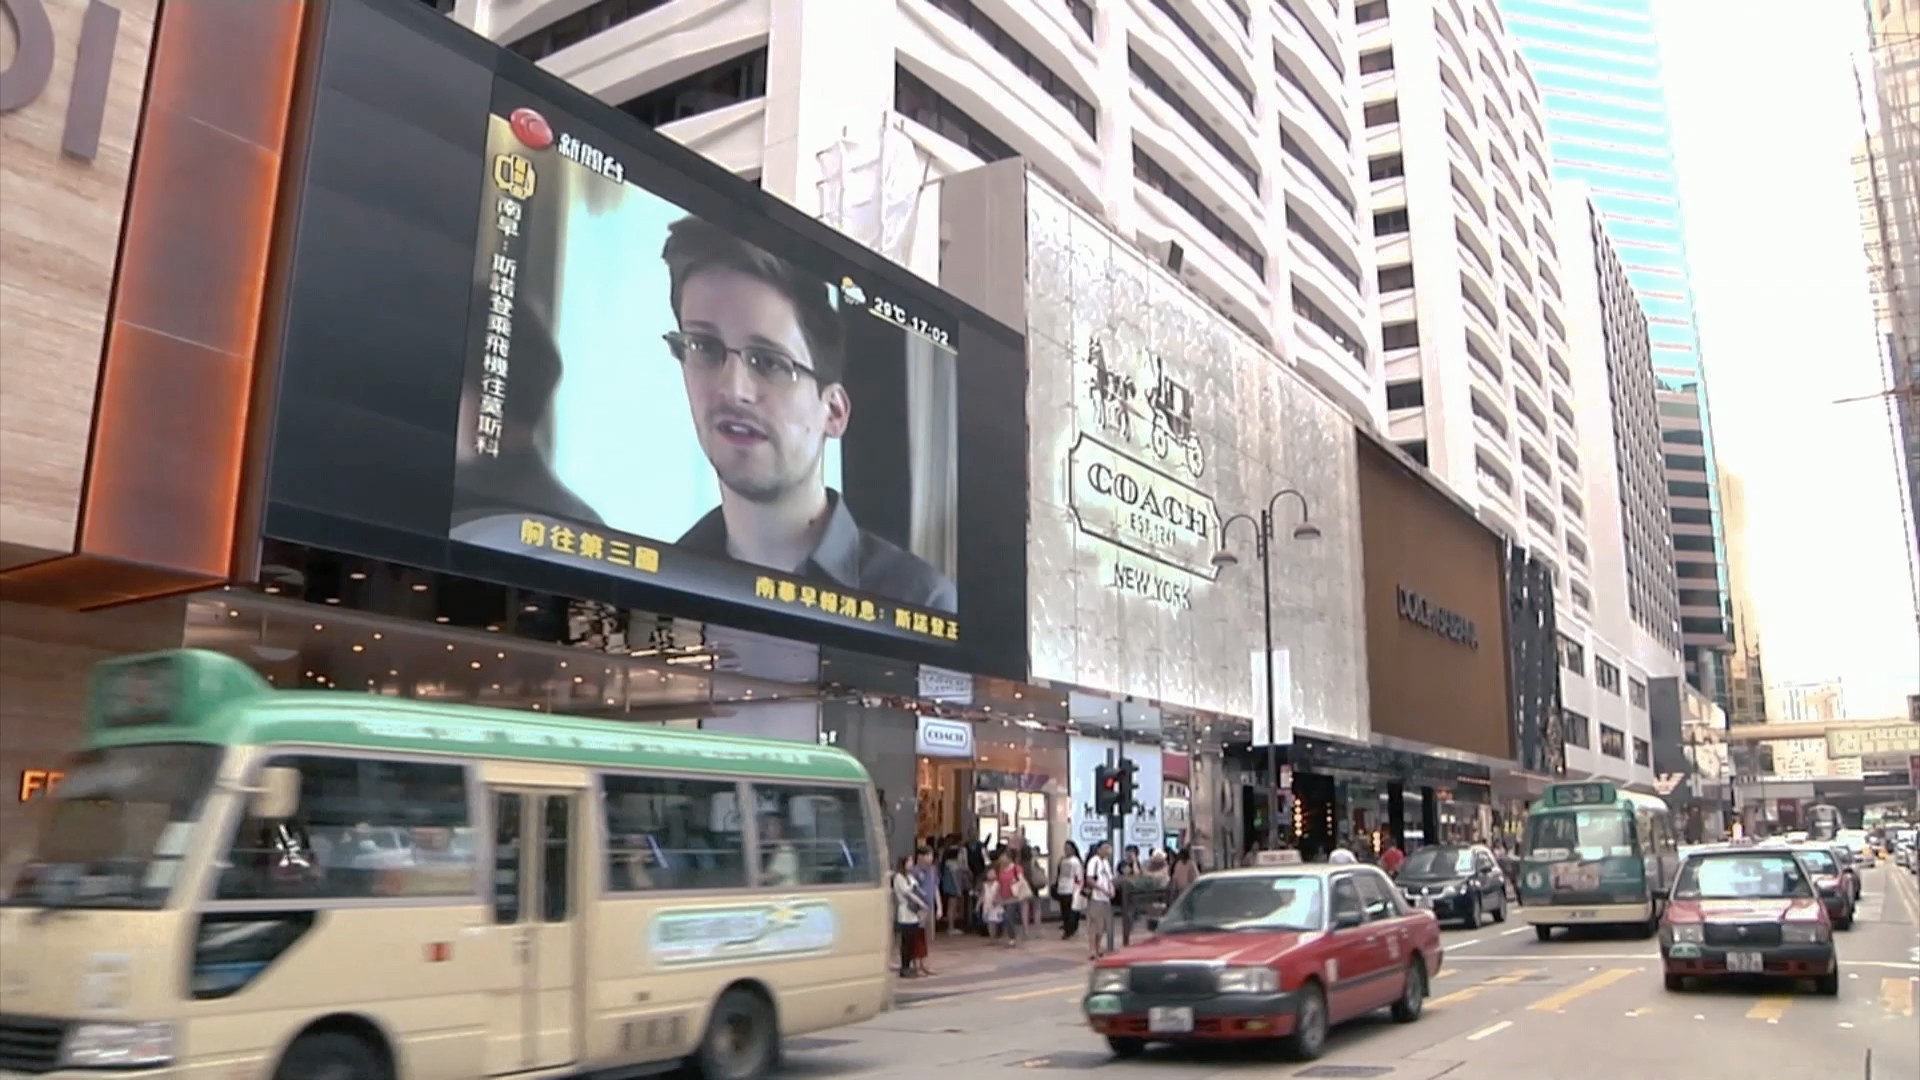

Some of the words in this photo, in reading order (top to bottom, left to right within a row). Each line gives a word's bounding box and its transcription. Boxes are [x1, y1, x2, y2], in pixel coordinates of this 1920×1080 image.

[558, 133, 624, 184] 新聞台
[912, 317, 949, 347] 17:02
[1088, 463, 1209, 540] COACH
[521, 518, 660, 574] 前往第三國
[1114, 562, 1153, 596] NEW
[1154, 575, 1193, 611] YORK
